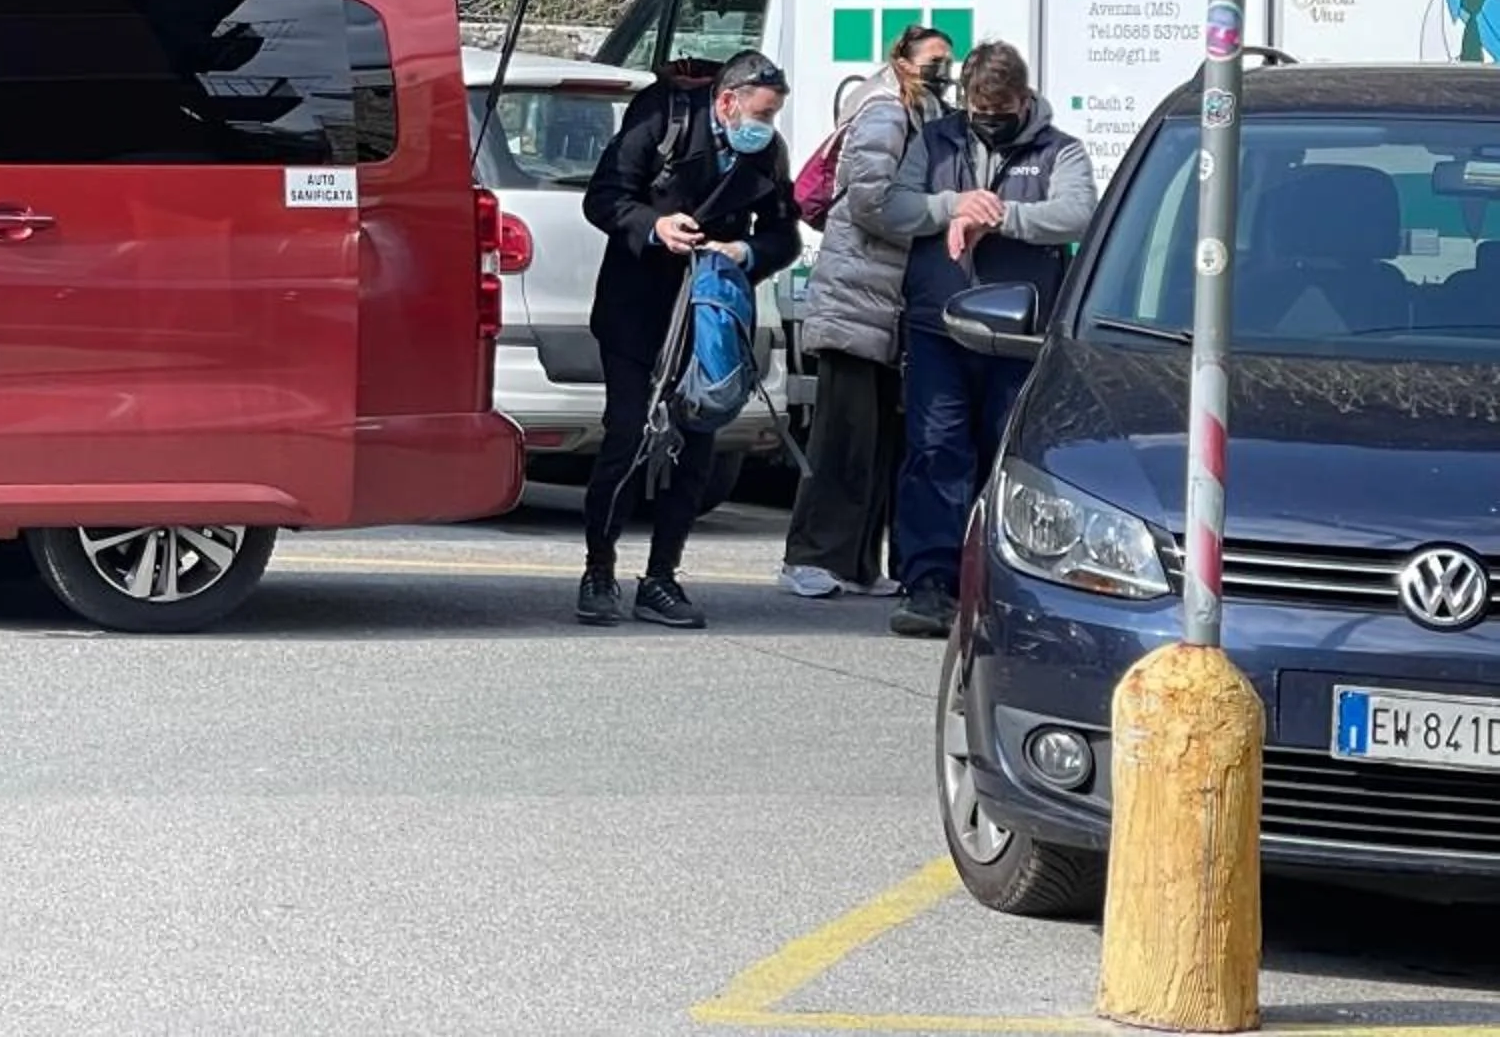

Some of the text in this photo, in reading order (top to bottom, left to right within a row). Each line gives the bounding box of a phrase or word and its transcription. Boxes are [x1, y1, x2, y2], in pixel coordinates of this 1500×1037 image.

[1143, 1, 1181, 19] (MS)
[1087, 95, 1136, 111] Cash 2
[307, 174, 335, 185] AUTO
[290, 190, 353, 202] SANIFICATA
[1371, 708, 1411, 747] EW
